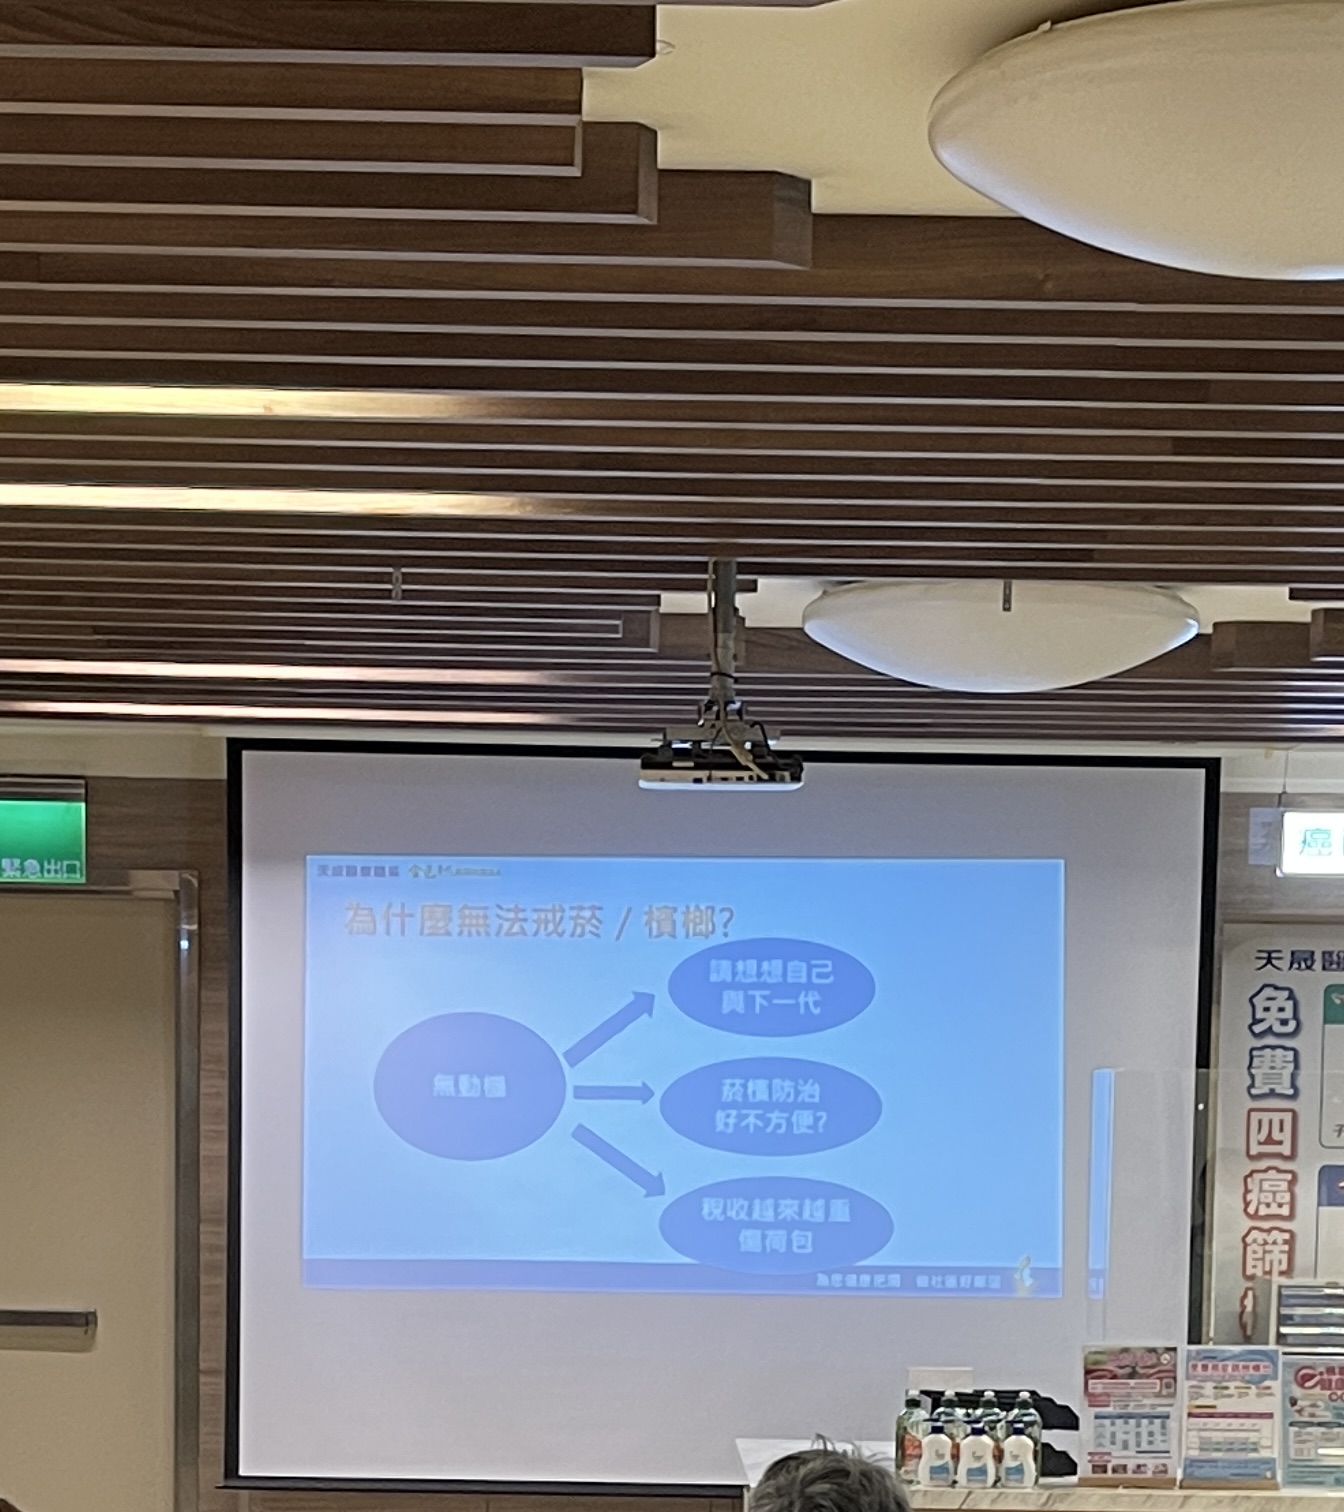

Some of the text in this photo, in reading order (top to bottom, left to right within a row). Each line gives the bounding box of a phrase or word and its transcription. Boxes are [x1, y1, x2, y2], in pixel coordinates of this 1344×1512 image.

[1, 858, 81, 879] 緊急出口
[344, 902, 604, 938] 為什麼無法戒菸
[721, 989, 822, 1015] 與下一代
